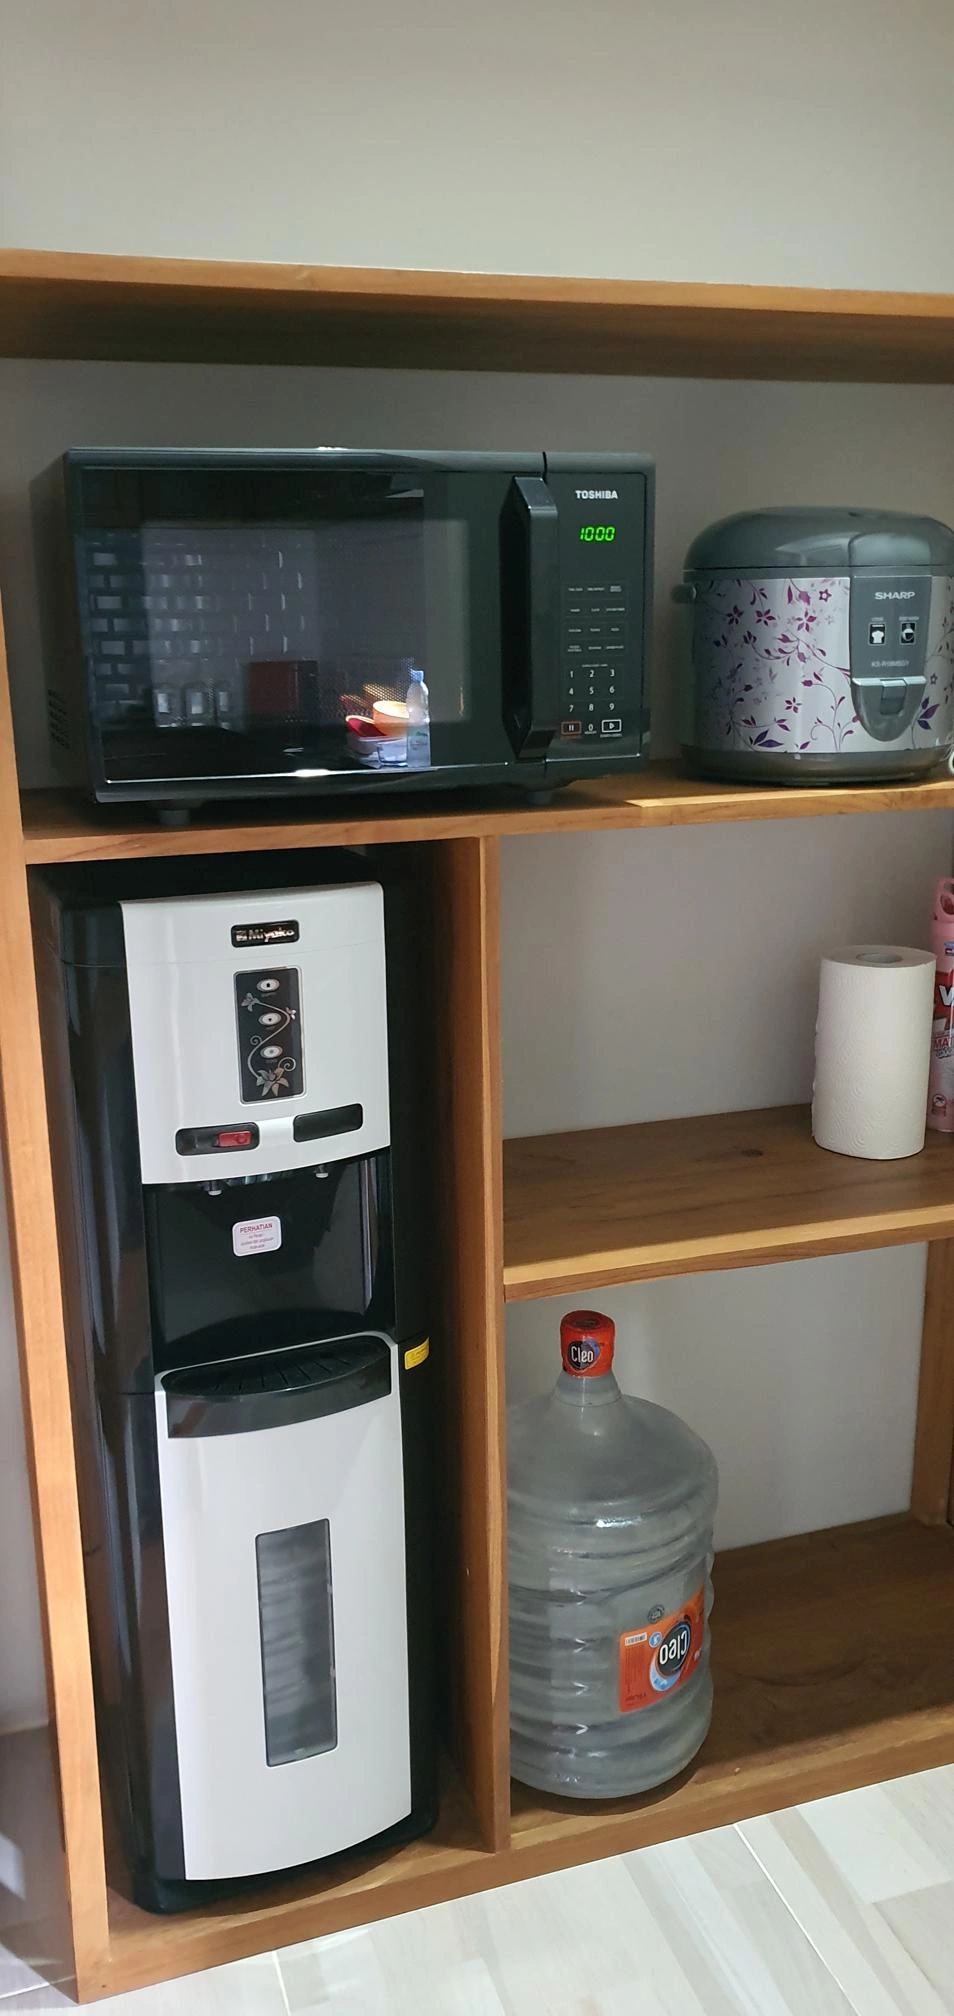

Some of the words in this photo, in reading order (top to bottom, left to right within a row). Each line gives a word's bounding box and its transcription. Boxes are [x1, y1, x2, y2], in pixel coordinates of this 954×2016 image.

[575, 490, 618, 499] TOSHIBA
[580, 526, 615, 541] 1000
[874, 591, 916, 600] SHARP
[569, 670, 574, 678] 1
[589, 669, 595, 678] 2
[610, 668, 615, 677] 3
[568, 687, 574, 695] 4
[589, 686, 594, 695] 5
[609, 685, 615, 694] 6
[569, 704, 574, 712] 7
[589, 703, 594, 711] 8
[609, 702, 615, 711] 9
[588, 723, 594, 731] 0
[239, 1222, 273, 1234] PERHATIAN
[571, 1346, 594, 1362] Cleo
[659, 1630, 687, 1665] Cleo
